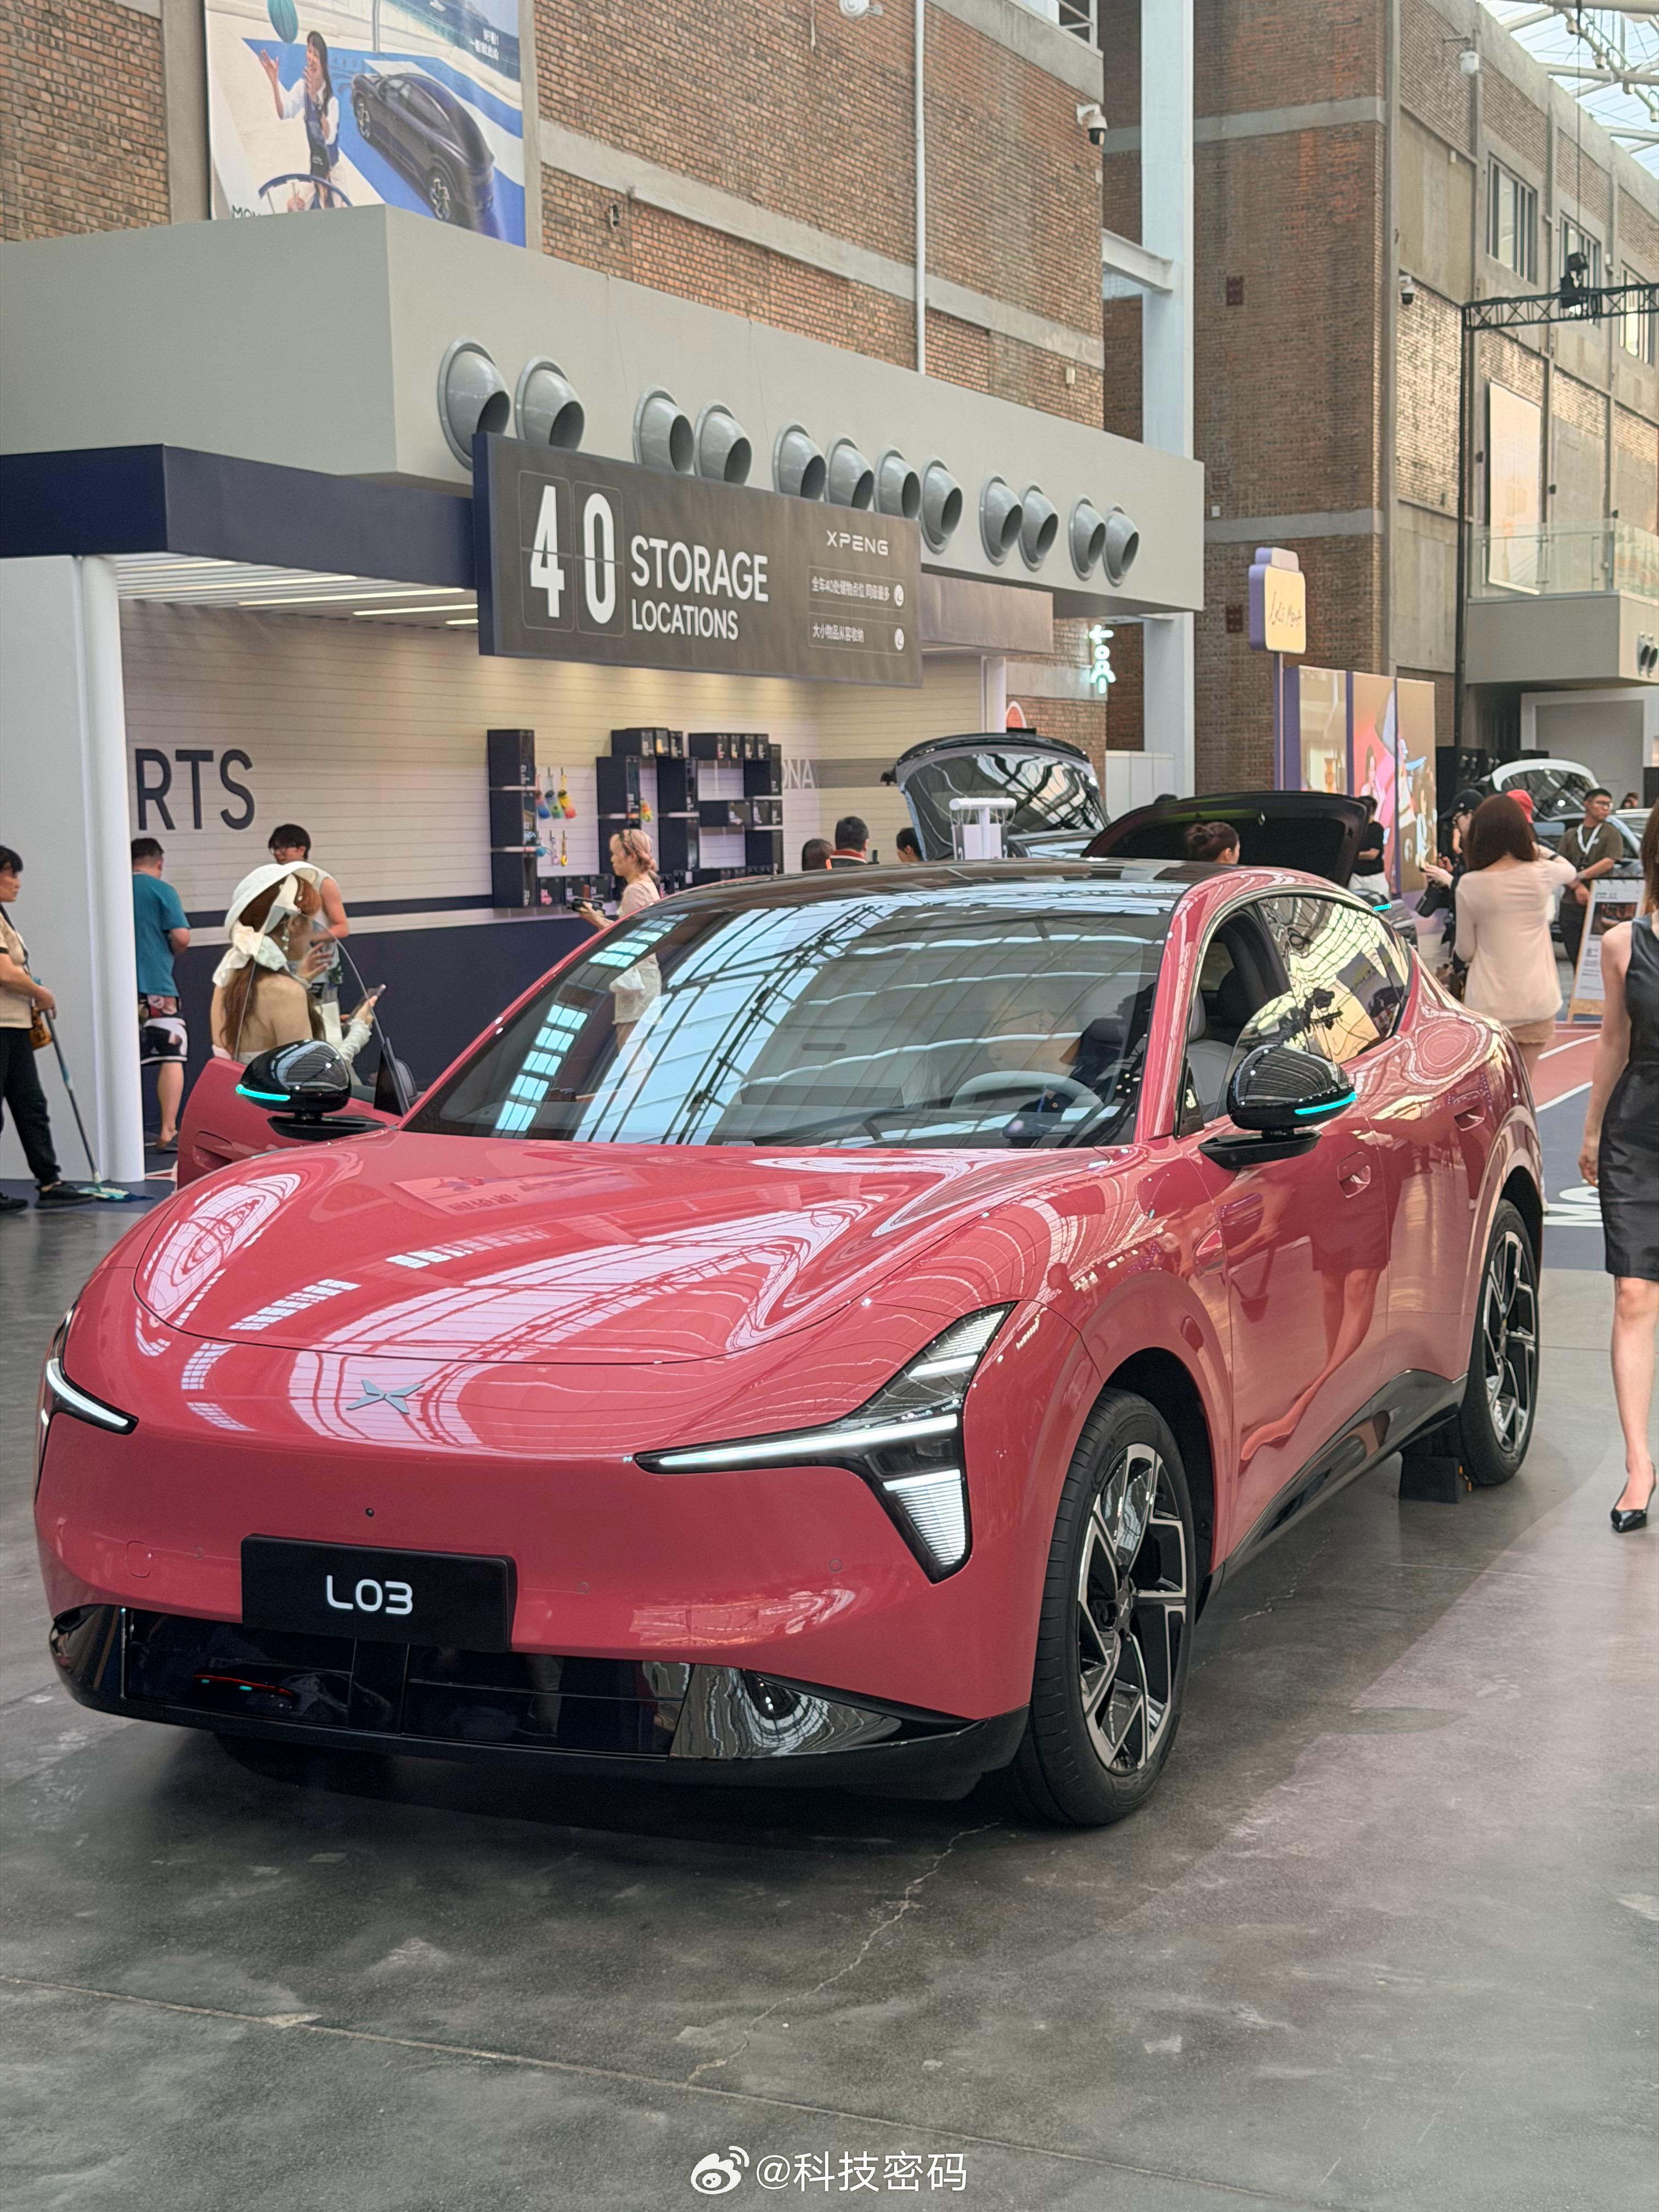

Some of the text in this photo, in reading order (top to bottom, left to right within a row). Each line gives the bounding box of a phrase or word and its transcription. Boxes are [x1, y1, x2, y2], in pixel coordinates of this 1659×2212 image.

[531, 484, 616, 624] 40
[631, 535, 769, 602] STORAGE
[826, 529, 889, 556] XPENG
[631, 598, 738, 640] LOCATIONS
[135, 748, 255, 831] RTS
